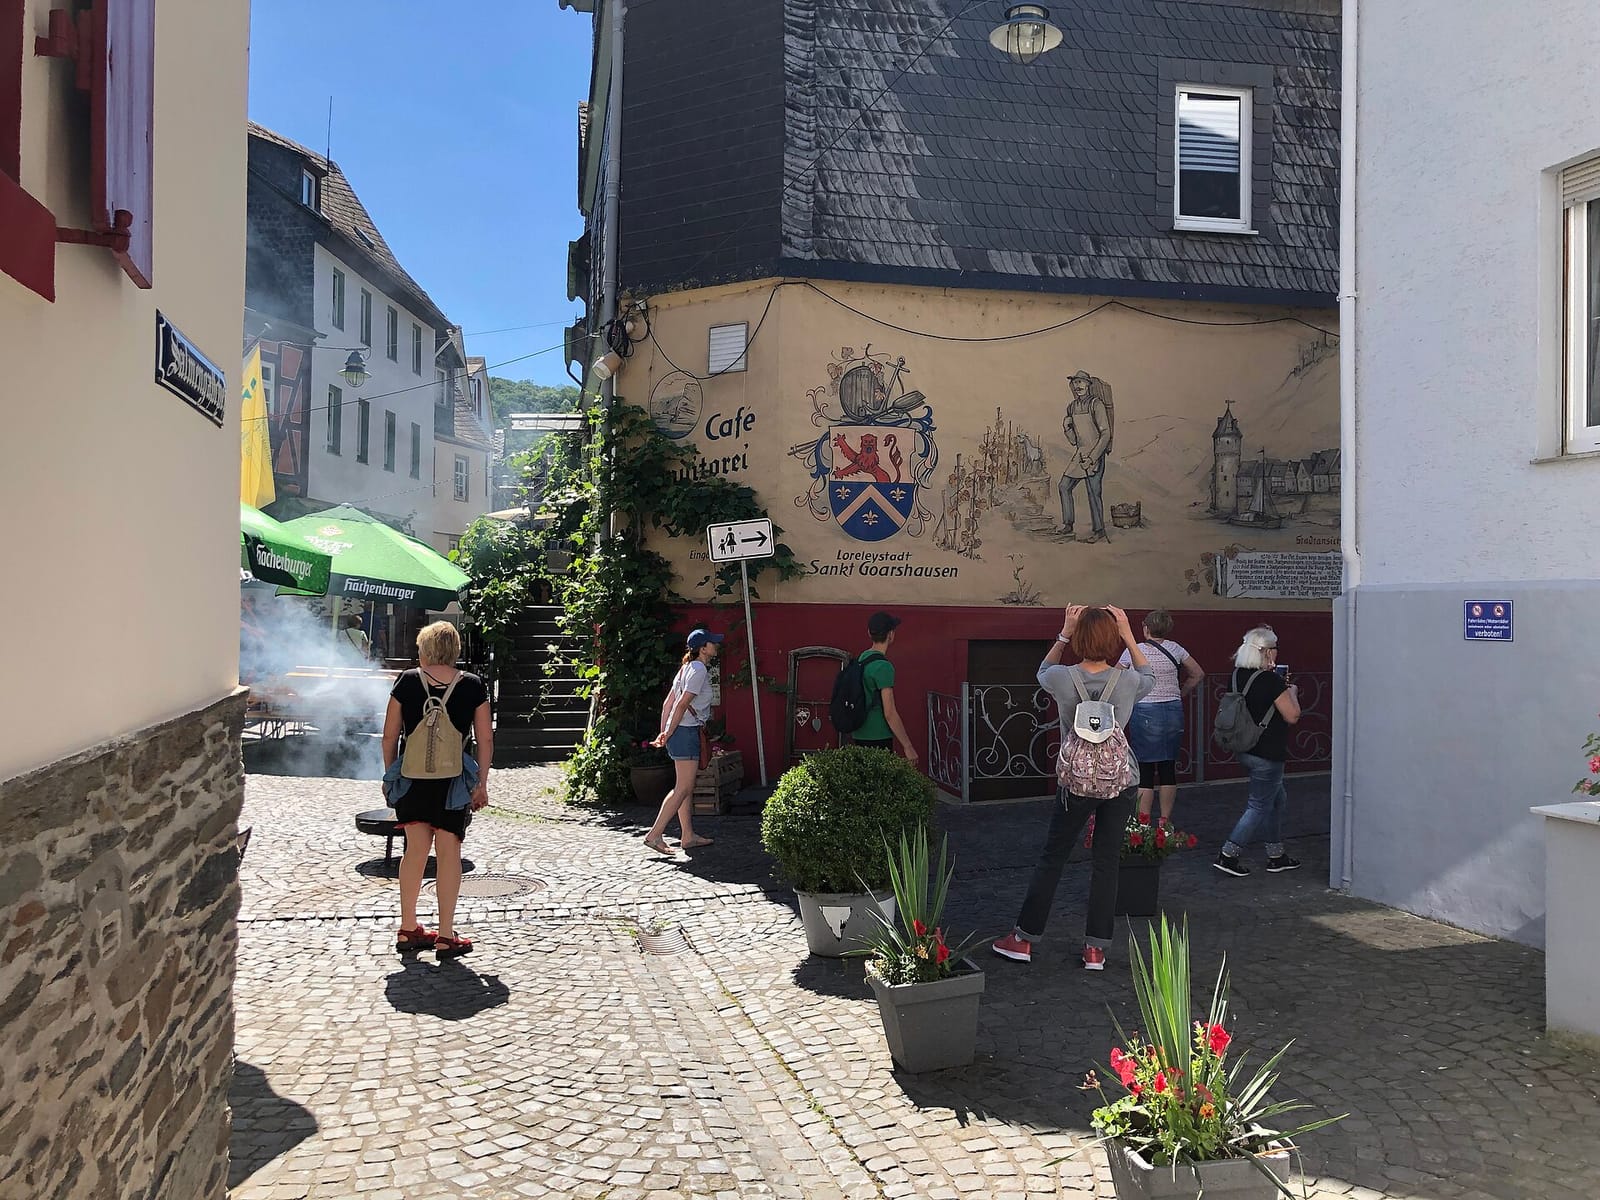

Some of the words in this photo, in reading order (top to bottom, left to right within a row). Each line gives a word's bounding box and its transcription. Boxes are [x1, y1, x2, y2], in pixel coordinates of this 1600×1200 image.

[705, 405, 756, 441] Café
[256, 544, 314, 580] Hachenburger
[836, 550, 913, 564] Loreleystadt
[806, 560, 855, 577] Sankt
[858, 562, 959, 578] Goarshausen
[343, 577, 416, 600] Hachenburger
[1474, 629, 1503, 638] verboten!
